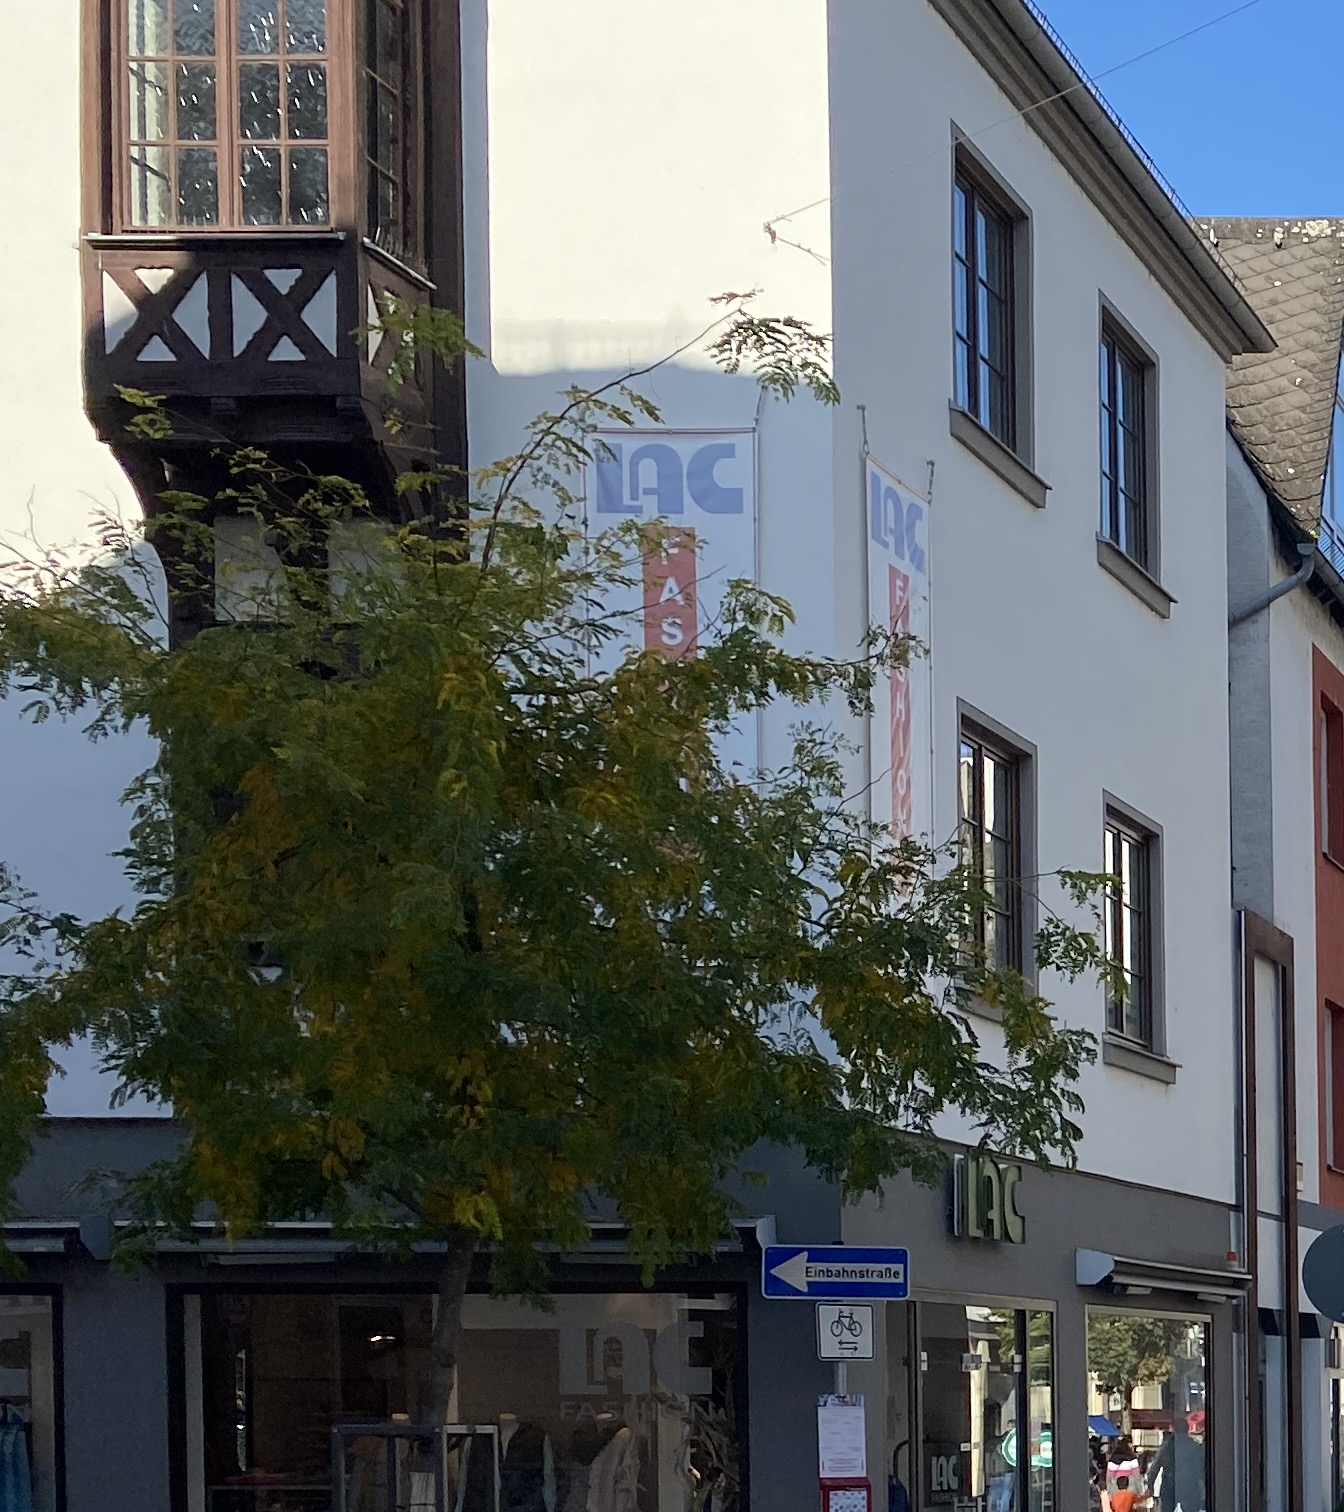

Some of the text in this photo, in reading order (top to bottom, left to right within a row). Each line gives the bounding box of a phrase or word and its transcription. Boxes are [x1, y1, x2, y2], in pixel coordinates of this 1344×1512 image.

[596, 442, 745, 515] LAC
[869, 469, 926, 573] LAC
[953, 1153, 1026, 1244] LAC
[804, 1265, 901, 1281] Einbahnstraße
[931, 1455, 959, 1491] LAC
